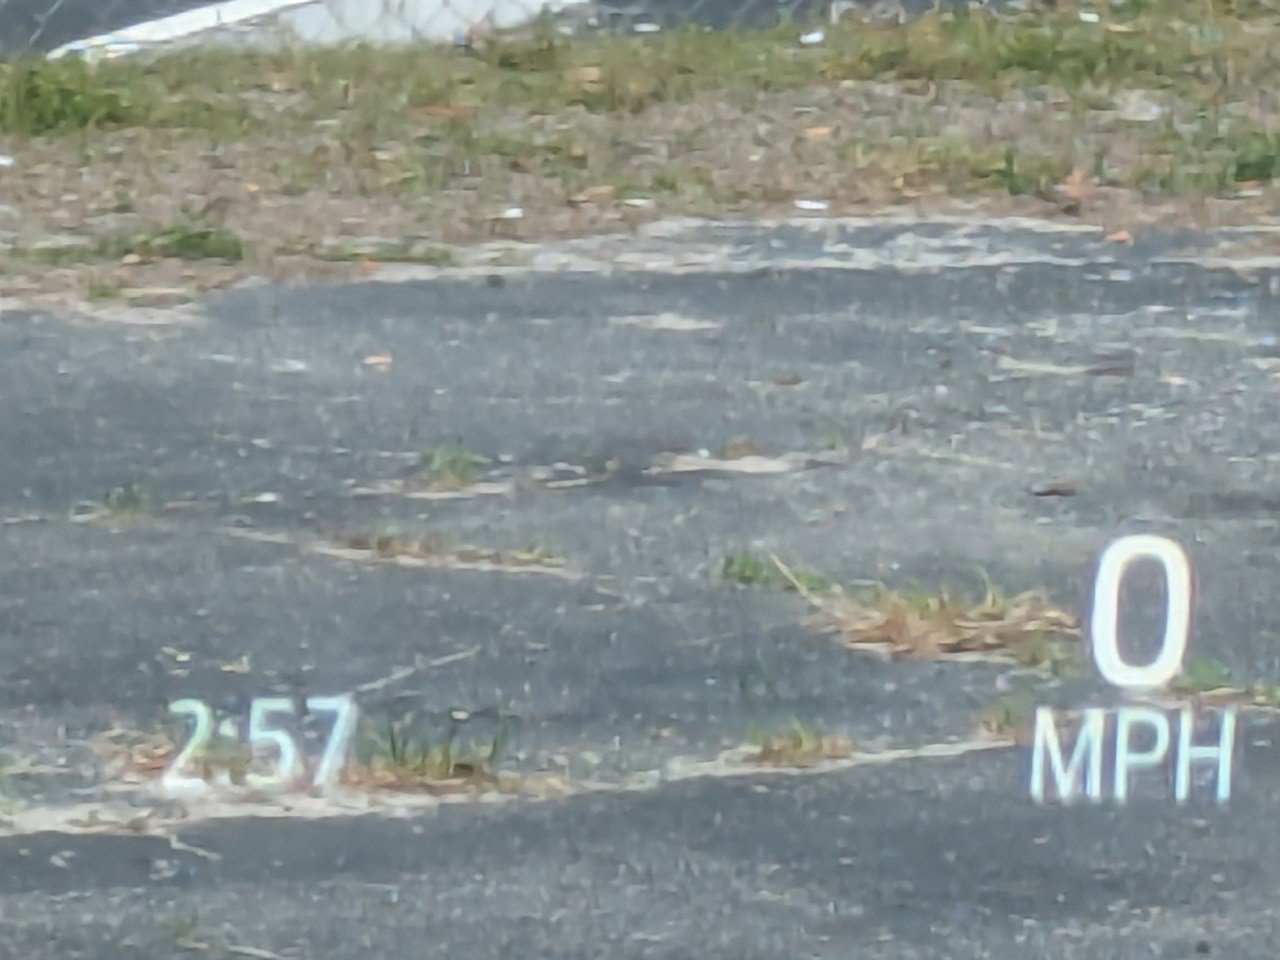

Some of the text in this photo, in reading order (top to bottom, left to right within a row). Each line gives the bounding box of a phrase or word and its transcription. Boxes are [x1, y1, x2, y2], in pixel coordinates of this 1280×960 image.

[1092, 532, 1192, 688] 0
[161, 696, 358, 792] 2:57
[1029, 705, 1238, 805] MPH
